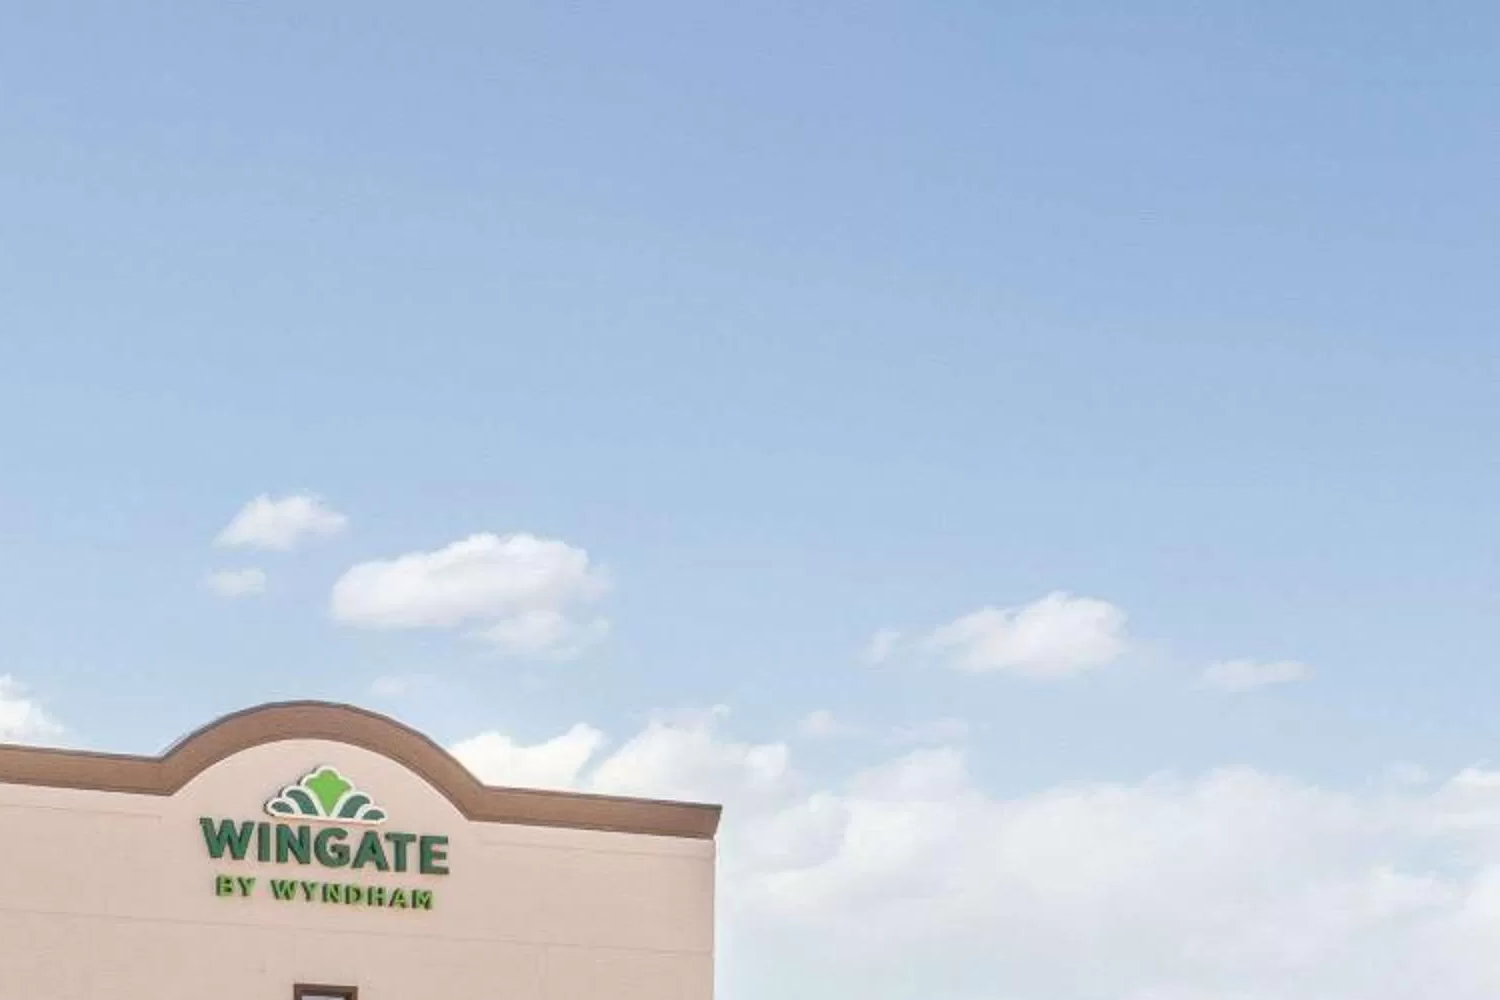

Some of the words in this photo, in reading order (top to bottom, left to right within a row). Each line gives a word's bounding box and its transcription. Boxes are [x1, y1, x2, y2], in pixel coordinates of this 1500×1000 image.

[199, 816, 450, 875] WINGATE
[215, 873, 256, 897] BY
[269, 878, 434, 911] WYNDHAM
